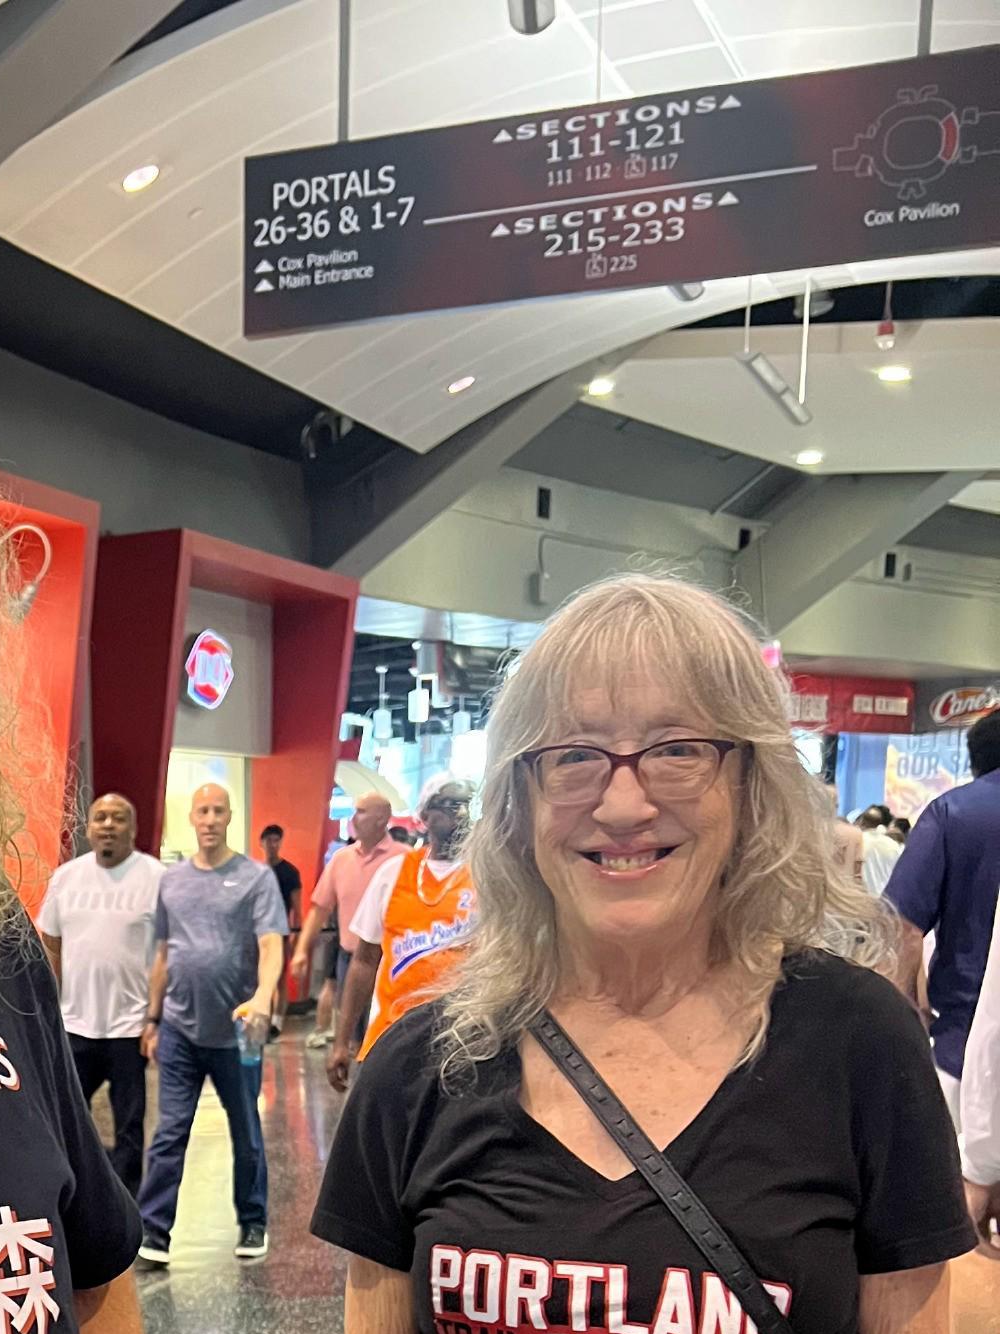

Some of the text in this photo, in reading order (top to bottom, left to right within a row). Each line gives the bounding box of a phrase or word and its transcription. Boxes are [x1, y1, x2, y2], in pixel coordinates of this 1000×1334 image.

[516, 95, 717, 140] SECTIONS
[546, 121, 685, 164] 111-121
[273, 165, 396, 211] PORTALS
[548, 154, 679, 187] 111 112 117
[254, 197, 415, 247] 26-36 & 1-7
[514, 192, 713, 234] SECTIONS
[864, 202, 960, 227] Cox Pavilion
[544, 217, 685, 257] 215-233
[278, 250, 359, 272] Cox Pavilion
[279, 265, 374, 290] Main Entrance
[610, 255, 637, 272] 225
